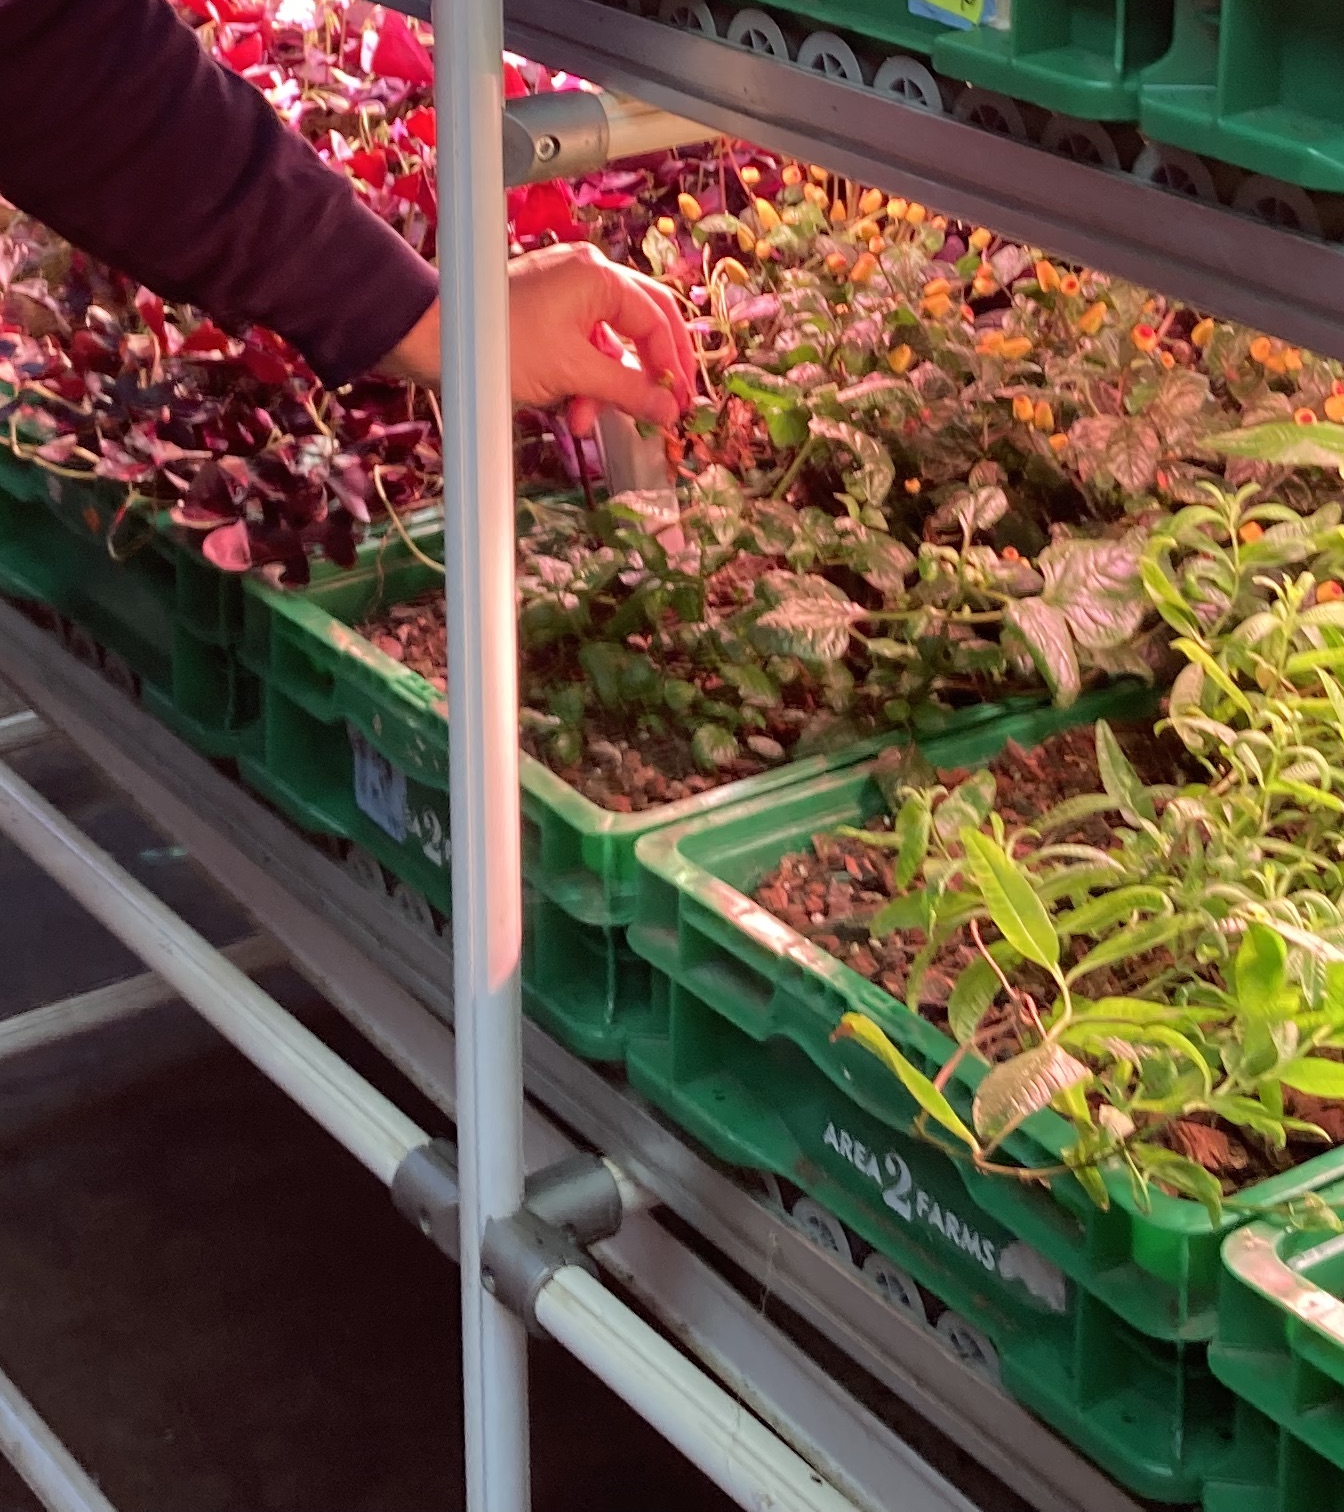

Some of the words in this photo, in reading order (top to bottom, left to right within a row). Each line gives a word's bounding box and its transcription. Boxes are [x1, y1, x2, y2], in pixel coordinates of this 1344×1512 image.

[822, 1121, 884, 1187] AREA
[881, 1151, 912, 1223] 2
[915, 1188, 996, 1272] FARMS
